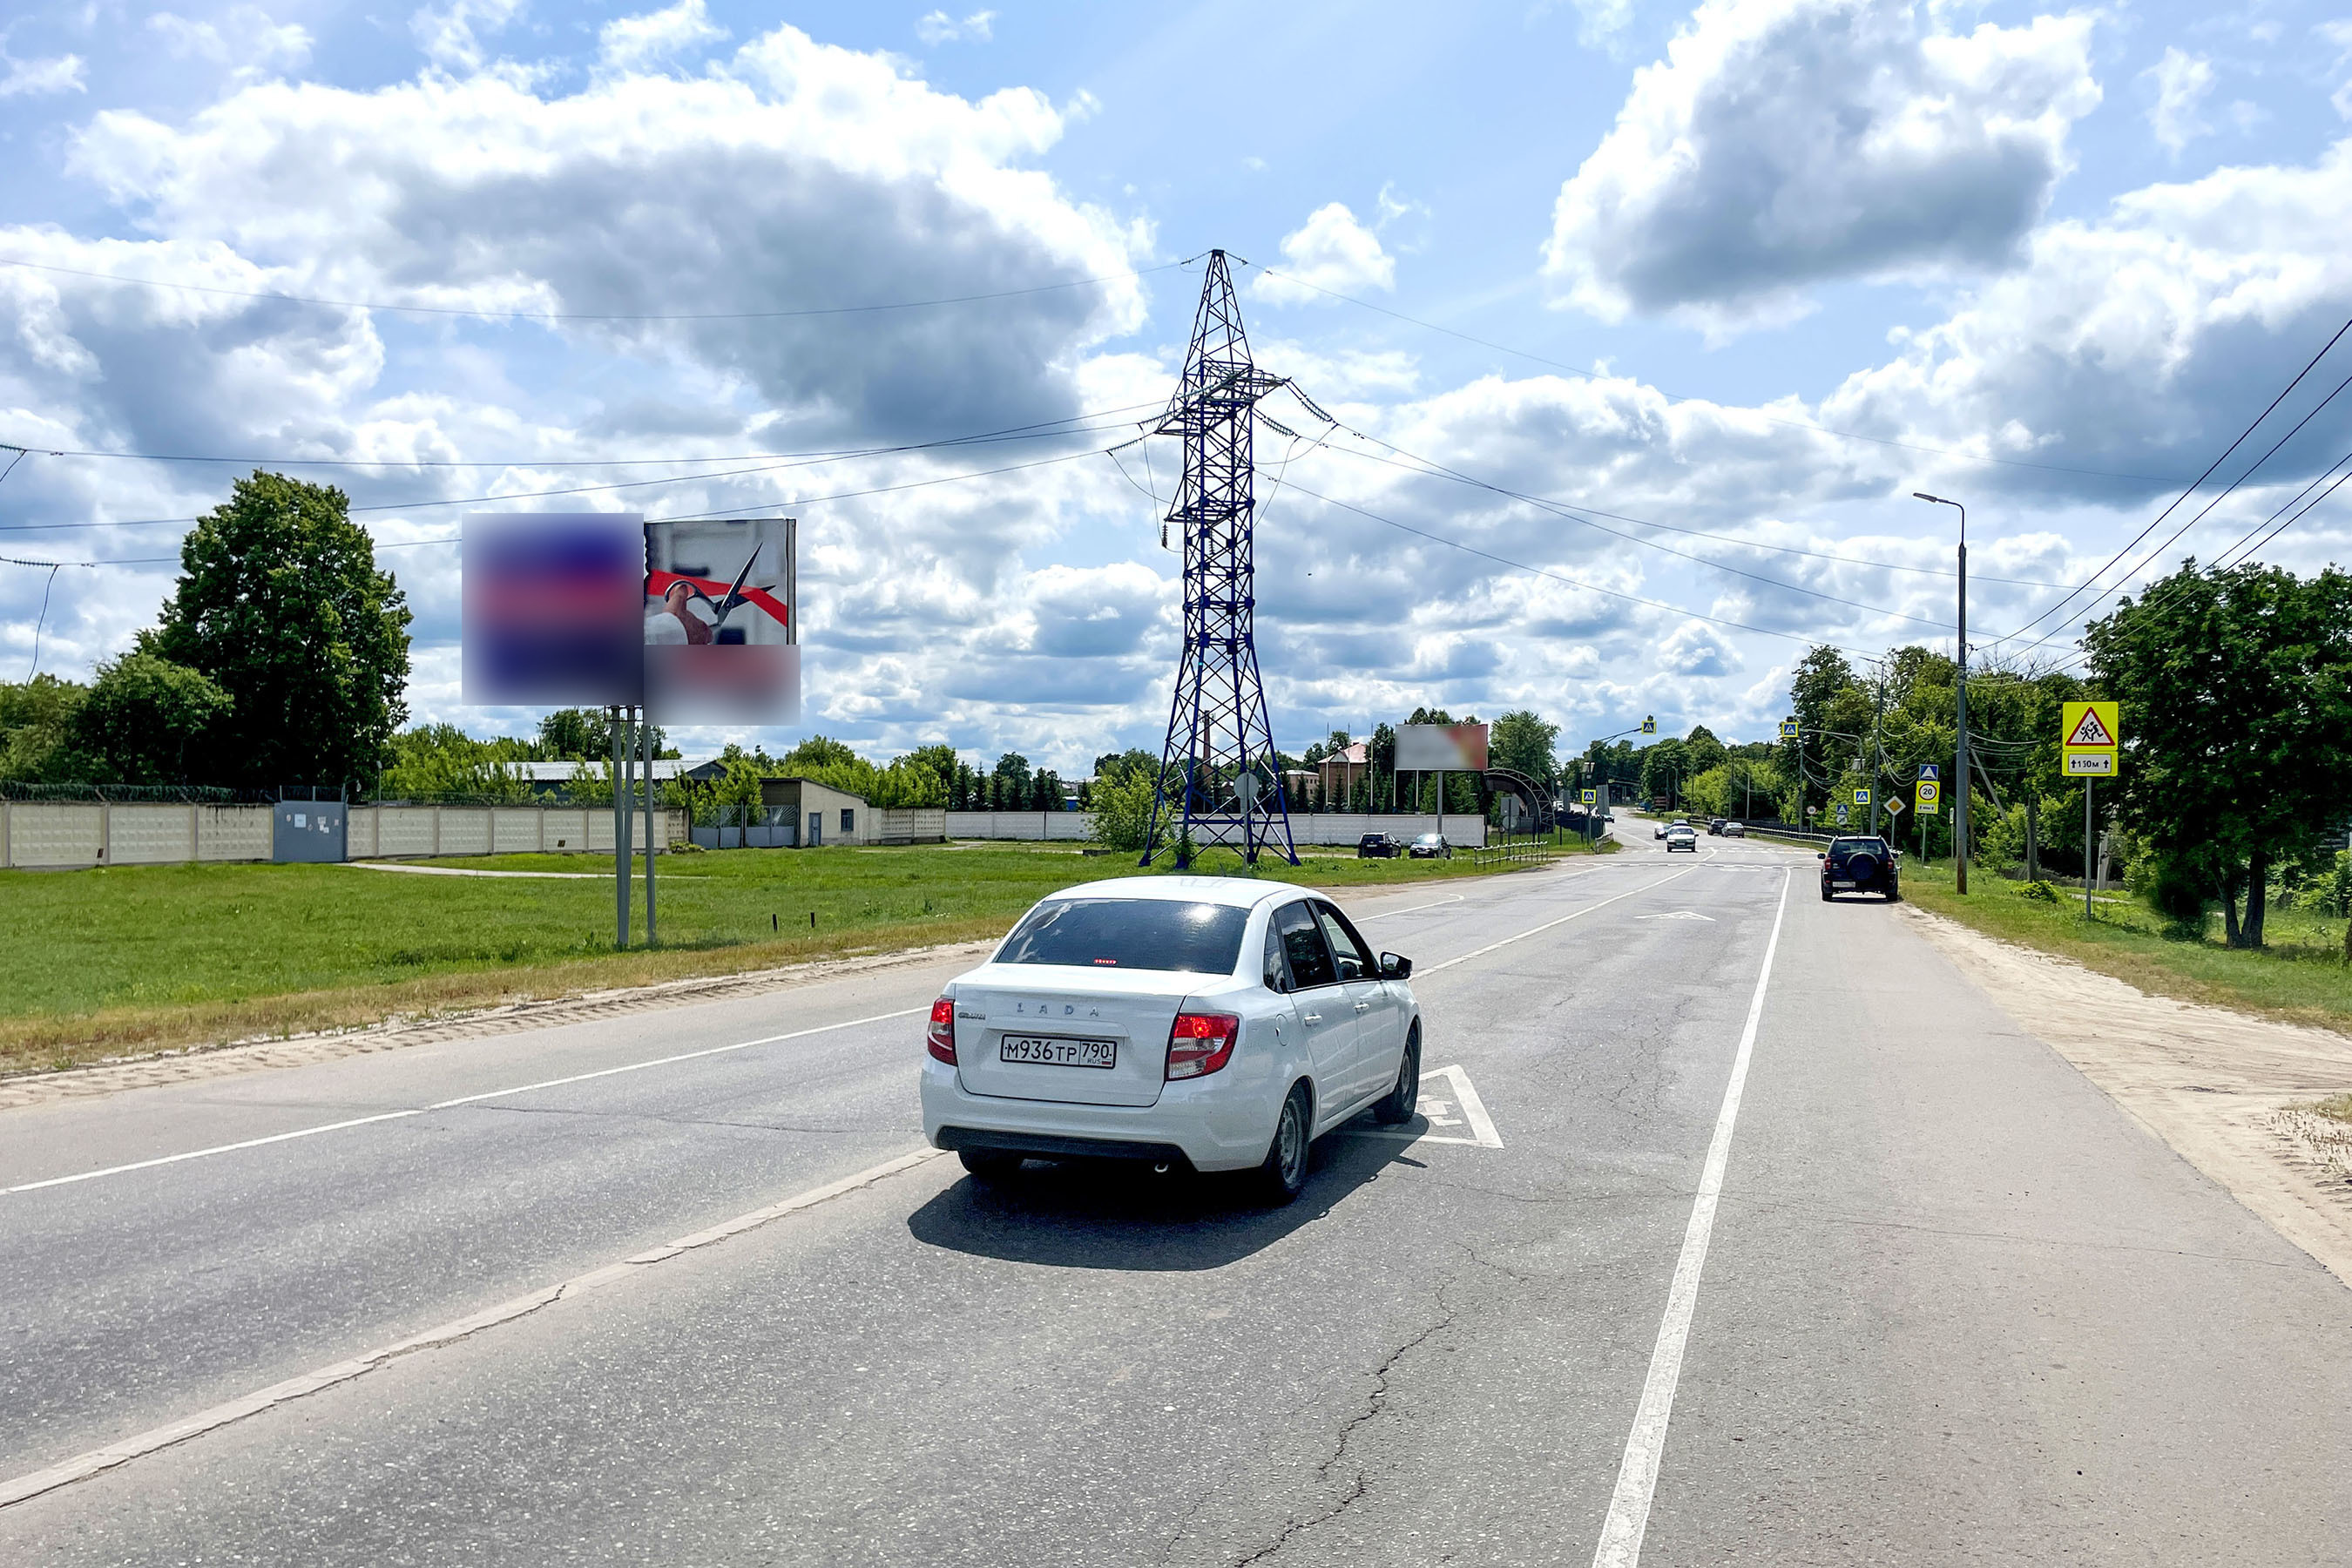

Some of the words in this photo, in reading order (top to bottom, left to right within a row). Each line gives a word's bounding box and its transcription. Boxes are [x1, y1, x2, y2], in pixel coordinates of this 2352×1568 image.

[1017, 1003, 1098, 1017] LADA
[1007, 1039, 1077, 1061] М936ТР
[1082, 1043, 1110, 1058] 790
